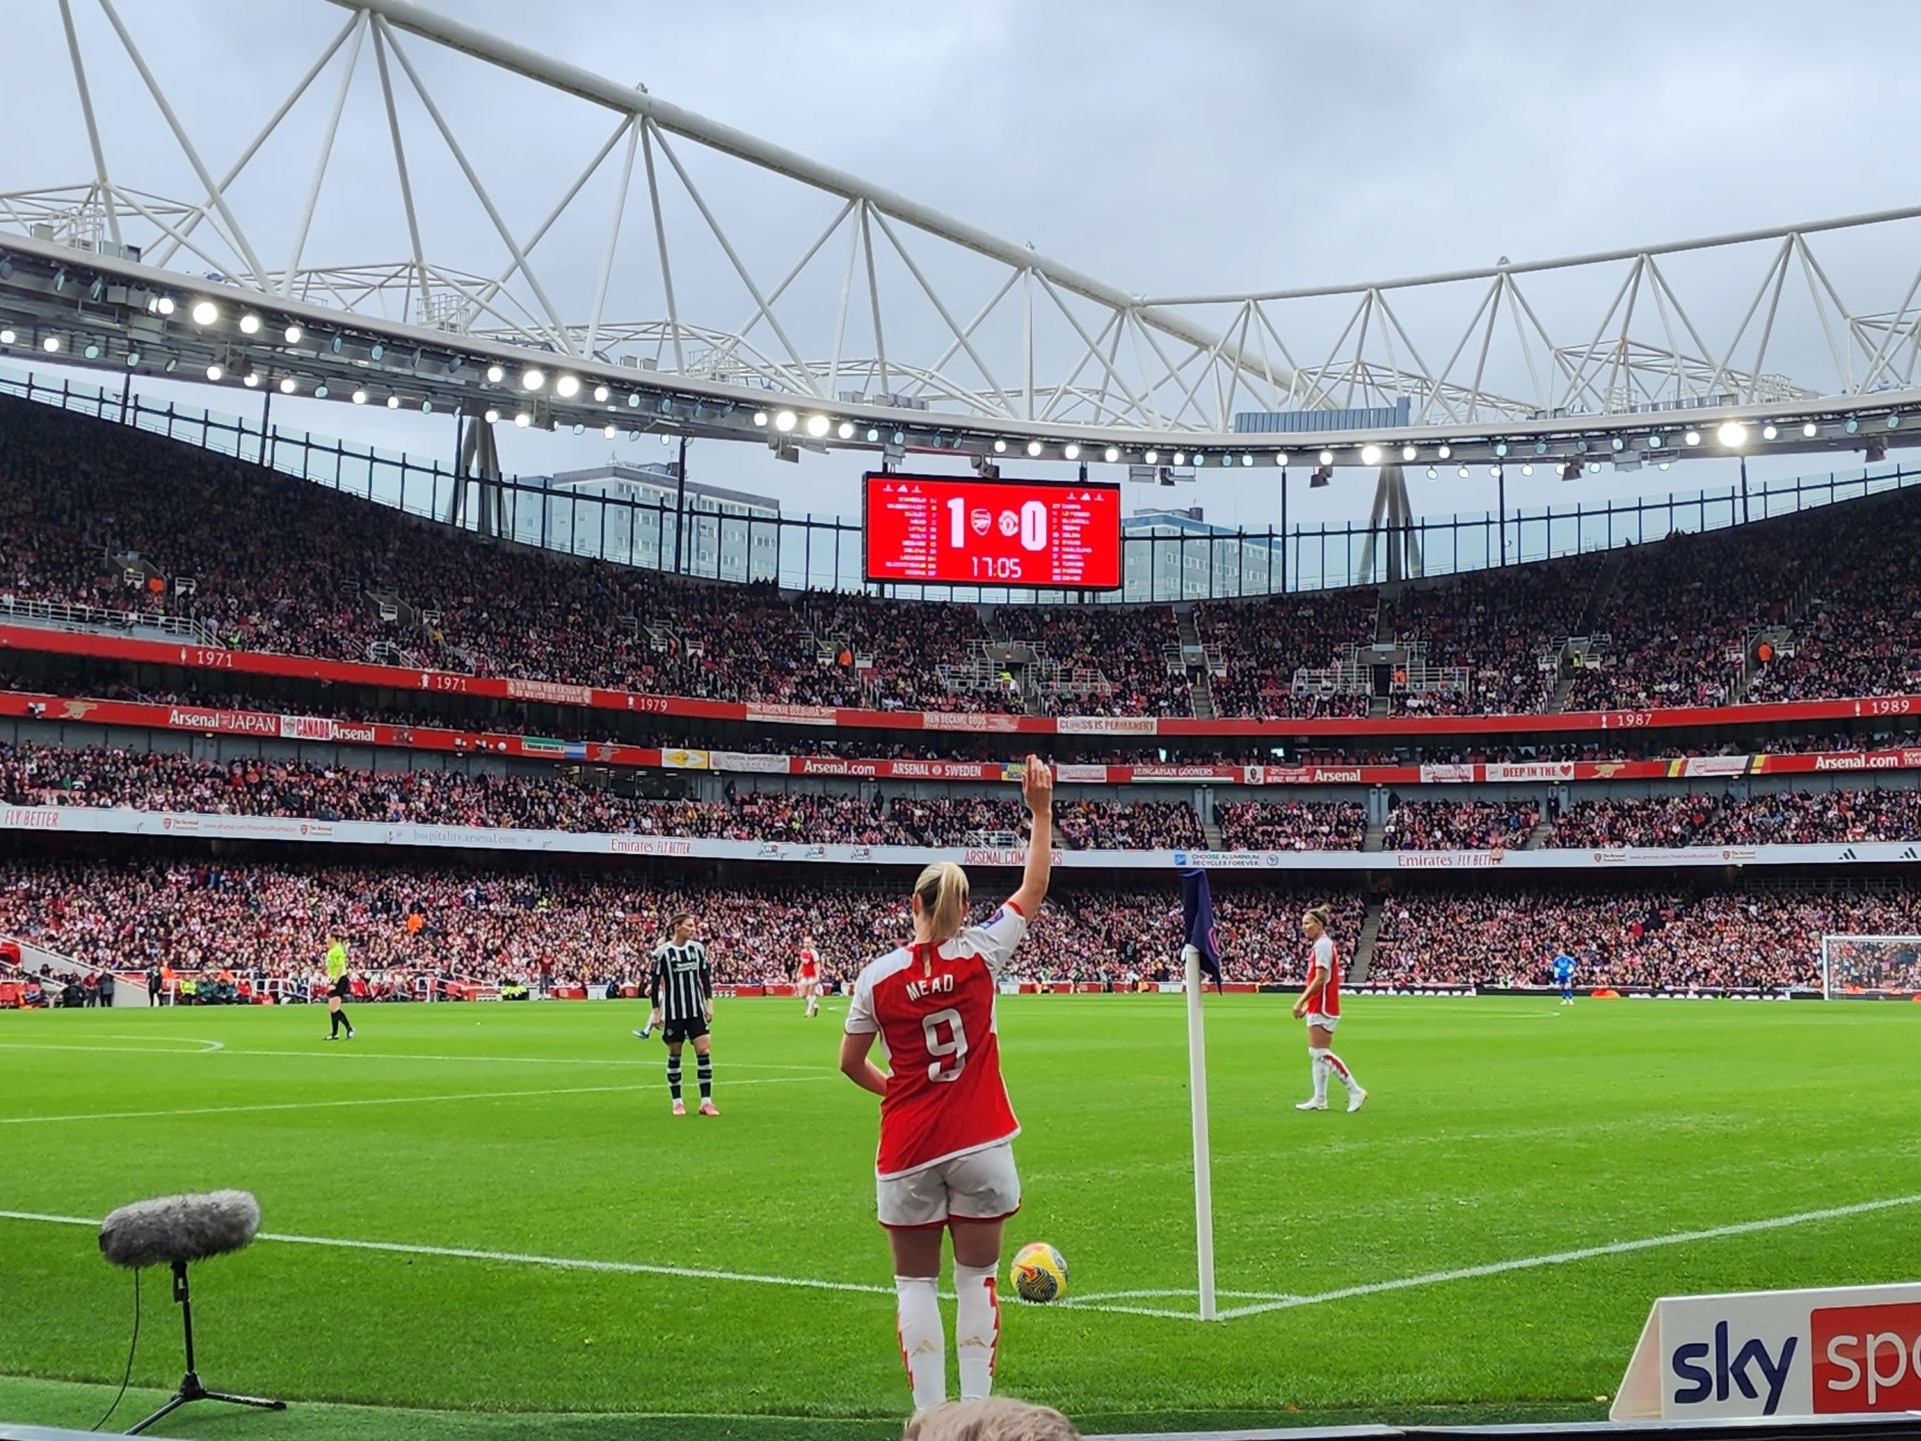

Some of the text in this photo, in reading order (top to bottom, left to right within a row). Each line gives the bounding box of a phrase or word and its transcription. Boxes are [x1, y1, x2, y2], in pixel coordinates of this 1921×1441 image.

[947, 497, 965, 548] 1
[1020, 500, 1048, 551] 0
[971, 556, 1022, 578] 17:05
[196, 651, 233, 668] 1971
[436, 676, 467, 692] 1971
[640, 698, 668, 712] 1979
[1871, 700, 1910, 715] 1989
[169, 709, 276, 732] Arsenal JAPAN
[297, 717, 331, 740] CANADA
[1105, 721, 1154, 731] PERMANENT
[1616, 713, 1652, 727] 1987
[331, 724, 375, 742] Arsenal
[804, 759, 876, 776] Arsenal.com
[892, 762, 982, 777] ARSENAL SWEDEN
[1815, 753, 1898, 770] Arsenal.com
[1314, 769, 1361, 782] Arsenal
[1503, 766, 1556, 777] DEEP IN THE
[4, 809, 58, 827] FLY BETTER
[611, 838, 654, 853] Emirates
[1398, 854, 1453, 867] Emirates
[1457, 855, 1471, 866] FLY
[905, 973, 954, 1001] MEAD
[921, 1008, 968, 1083] 9
[1672, 1320, 1798, 1415] sky
[1827, 1332, 1921, 1405] sp
